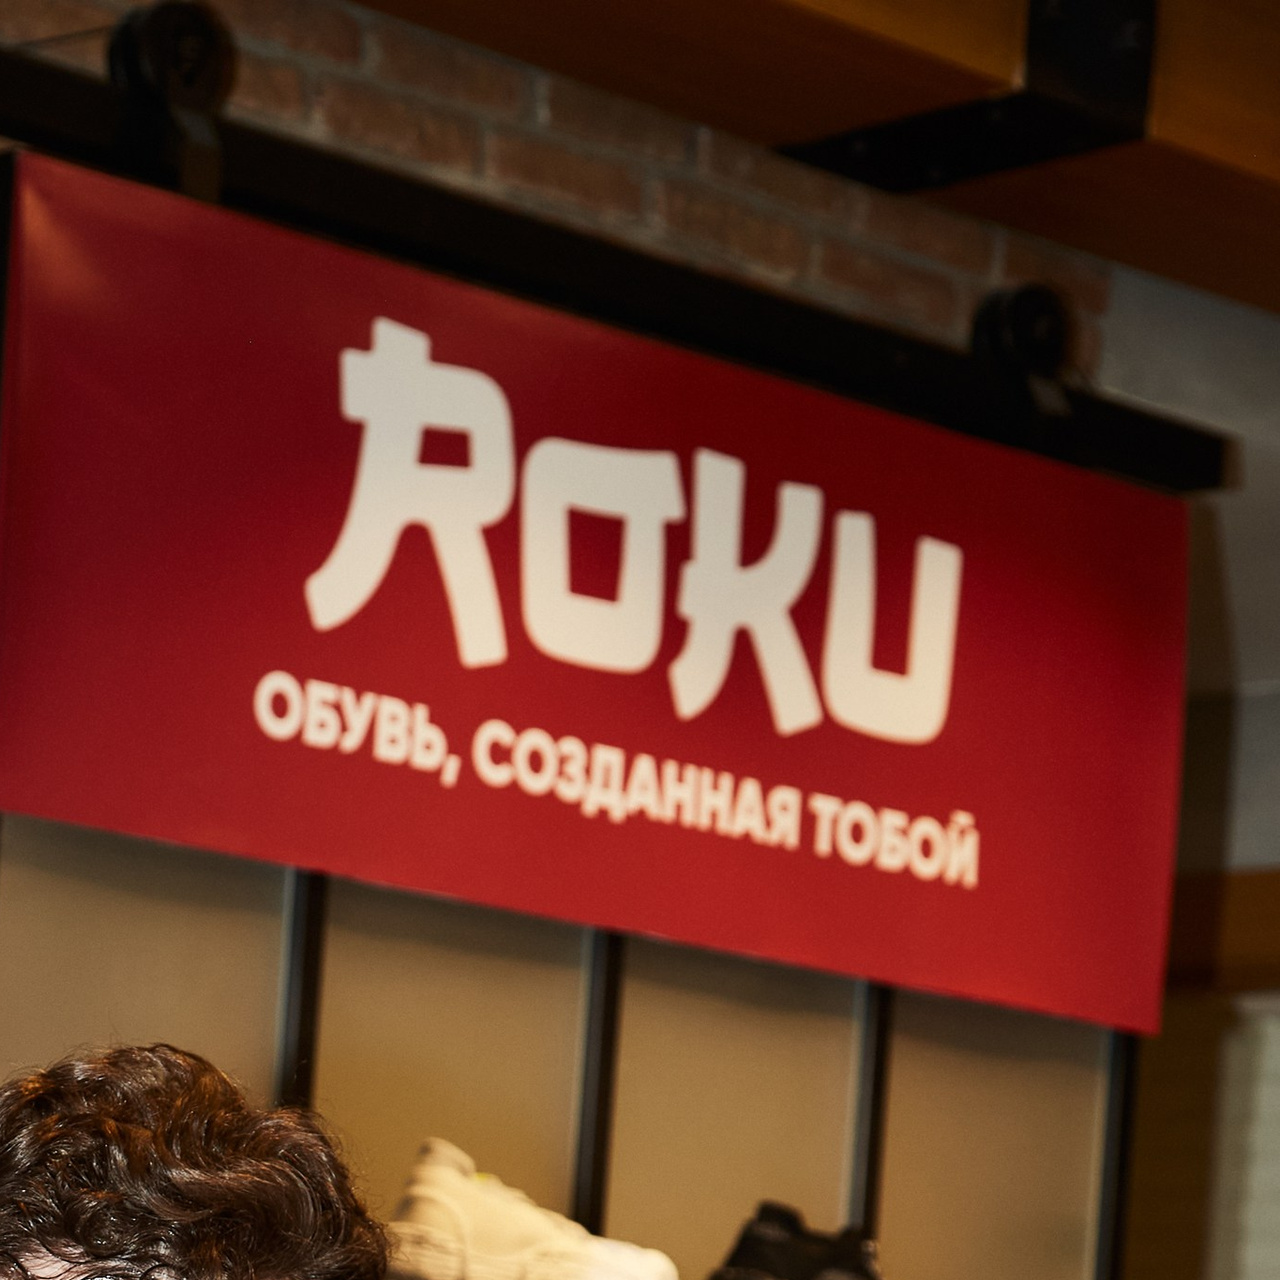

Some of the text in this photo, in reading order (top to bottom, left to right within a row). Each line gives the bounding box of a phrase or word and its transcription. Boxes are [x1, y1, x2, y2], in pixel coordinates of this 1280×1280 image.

[305, 316, 962, 744] ROKU
[253, 669, 979, 889] ОБУВЬ, СОЗДАННАЯ ТОБОЙ
